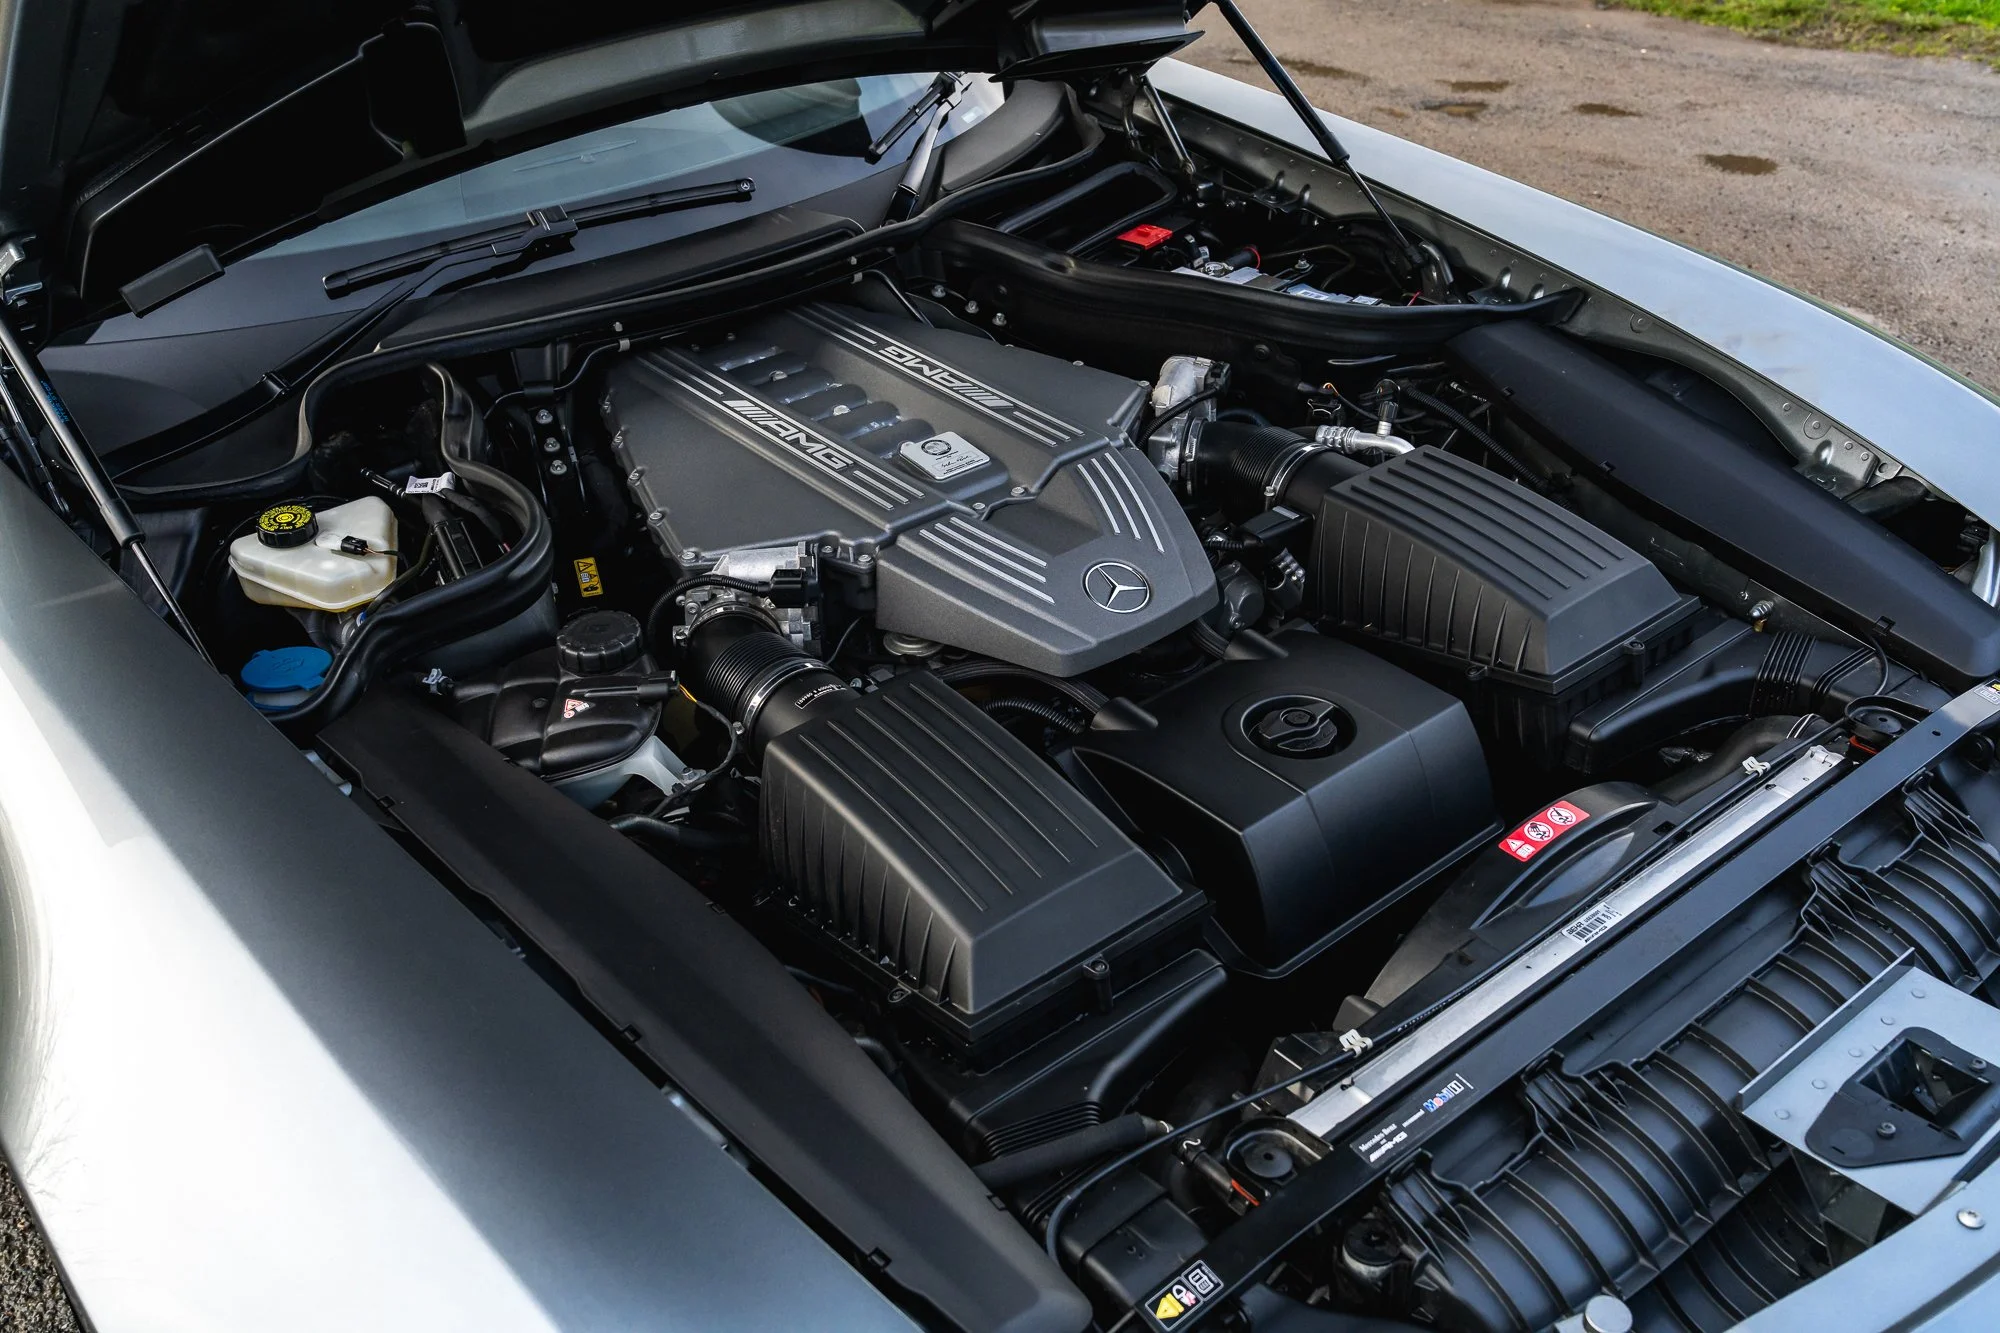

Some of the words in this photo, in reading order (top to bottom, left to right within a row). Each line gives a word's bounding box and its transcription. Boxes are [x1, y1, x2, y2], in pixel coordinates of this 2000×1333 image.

[878, 345, 974, 388] AMG
[757, 420, 854, 470] AMG
[1566, 921, 1584, 935] BEHR
[1423, 1087, 1454, 1113] Mobil
